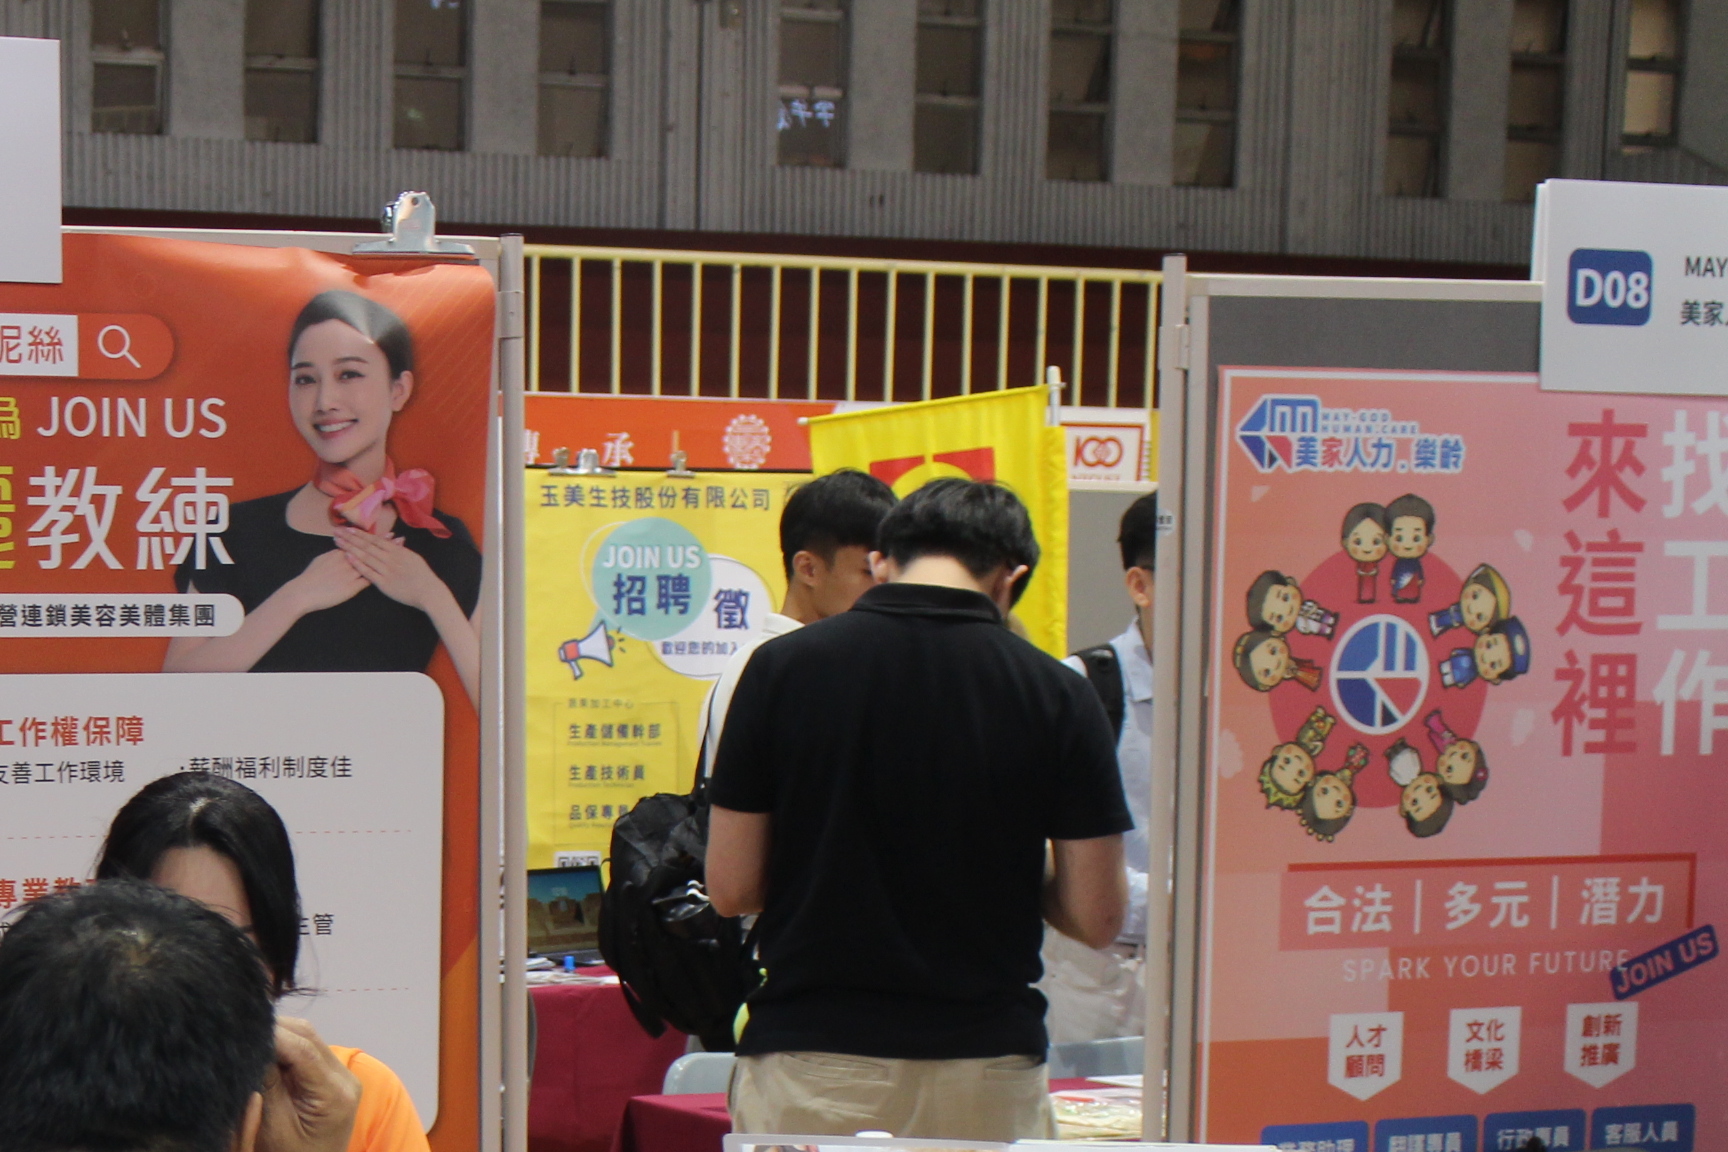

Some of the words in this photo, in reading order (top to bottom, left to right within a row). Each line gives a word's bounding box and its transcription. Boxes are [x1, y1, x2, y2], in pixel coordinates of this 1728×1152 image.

[1575, 268, 1650, 310] D08
[1680, 299, 1728, 326] 美家
[37, 396, 148, 439] JOIN
[165, 397, 229, 439] US
[540, 484, 771, 511] 玉美生技股份有限公司
[602, 544, 661, 571] JOIN
[667, 544, 703, 571] US
[612, 573, 692, 617] 招聘
[1550, 408, 1649, 757] 來這裡
[713, 588, 751, 631] 徵
[1304, 884, 1394, 936] 合法
[1444, 880, 1530, 930] 多元
[1579, 876, 1665, 926] 潛力
[1342, 956, 1432, 983] SPARK
[1443, 952, 1517, 978] YOUR
[1529, 949, 1630, 976] FUTURE
[1614, 950, 1675, 996] JOIN
[1679, 933, 1716, 965] US
[1345, 1024, 1387, 1050] 人才
[1466, 1018, 1506, 1043] 文化
[1581, 1013, 1623, 1039] 創新
[1344, 1052, 1386, 1079] 顧問
[1464, 1047, 1504, 1074] 橋梁
[1579, 1043, 1621, 1068] 推廣
[1604, 1120, 1679, 1145] 客服人員
